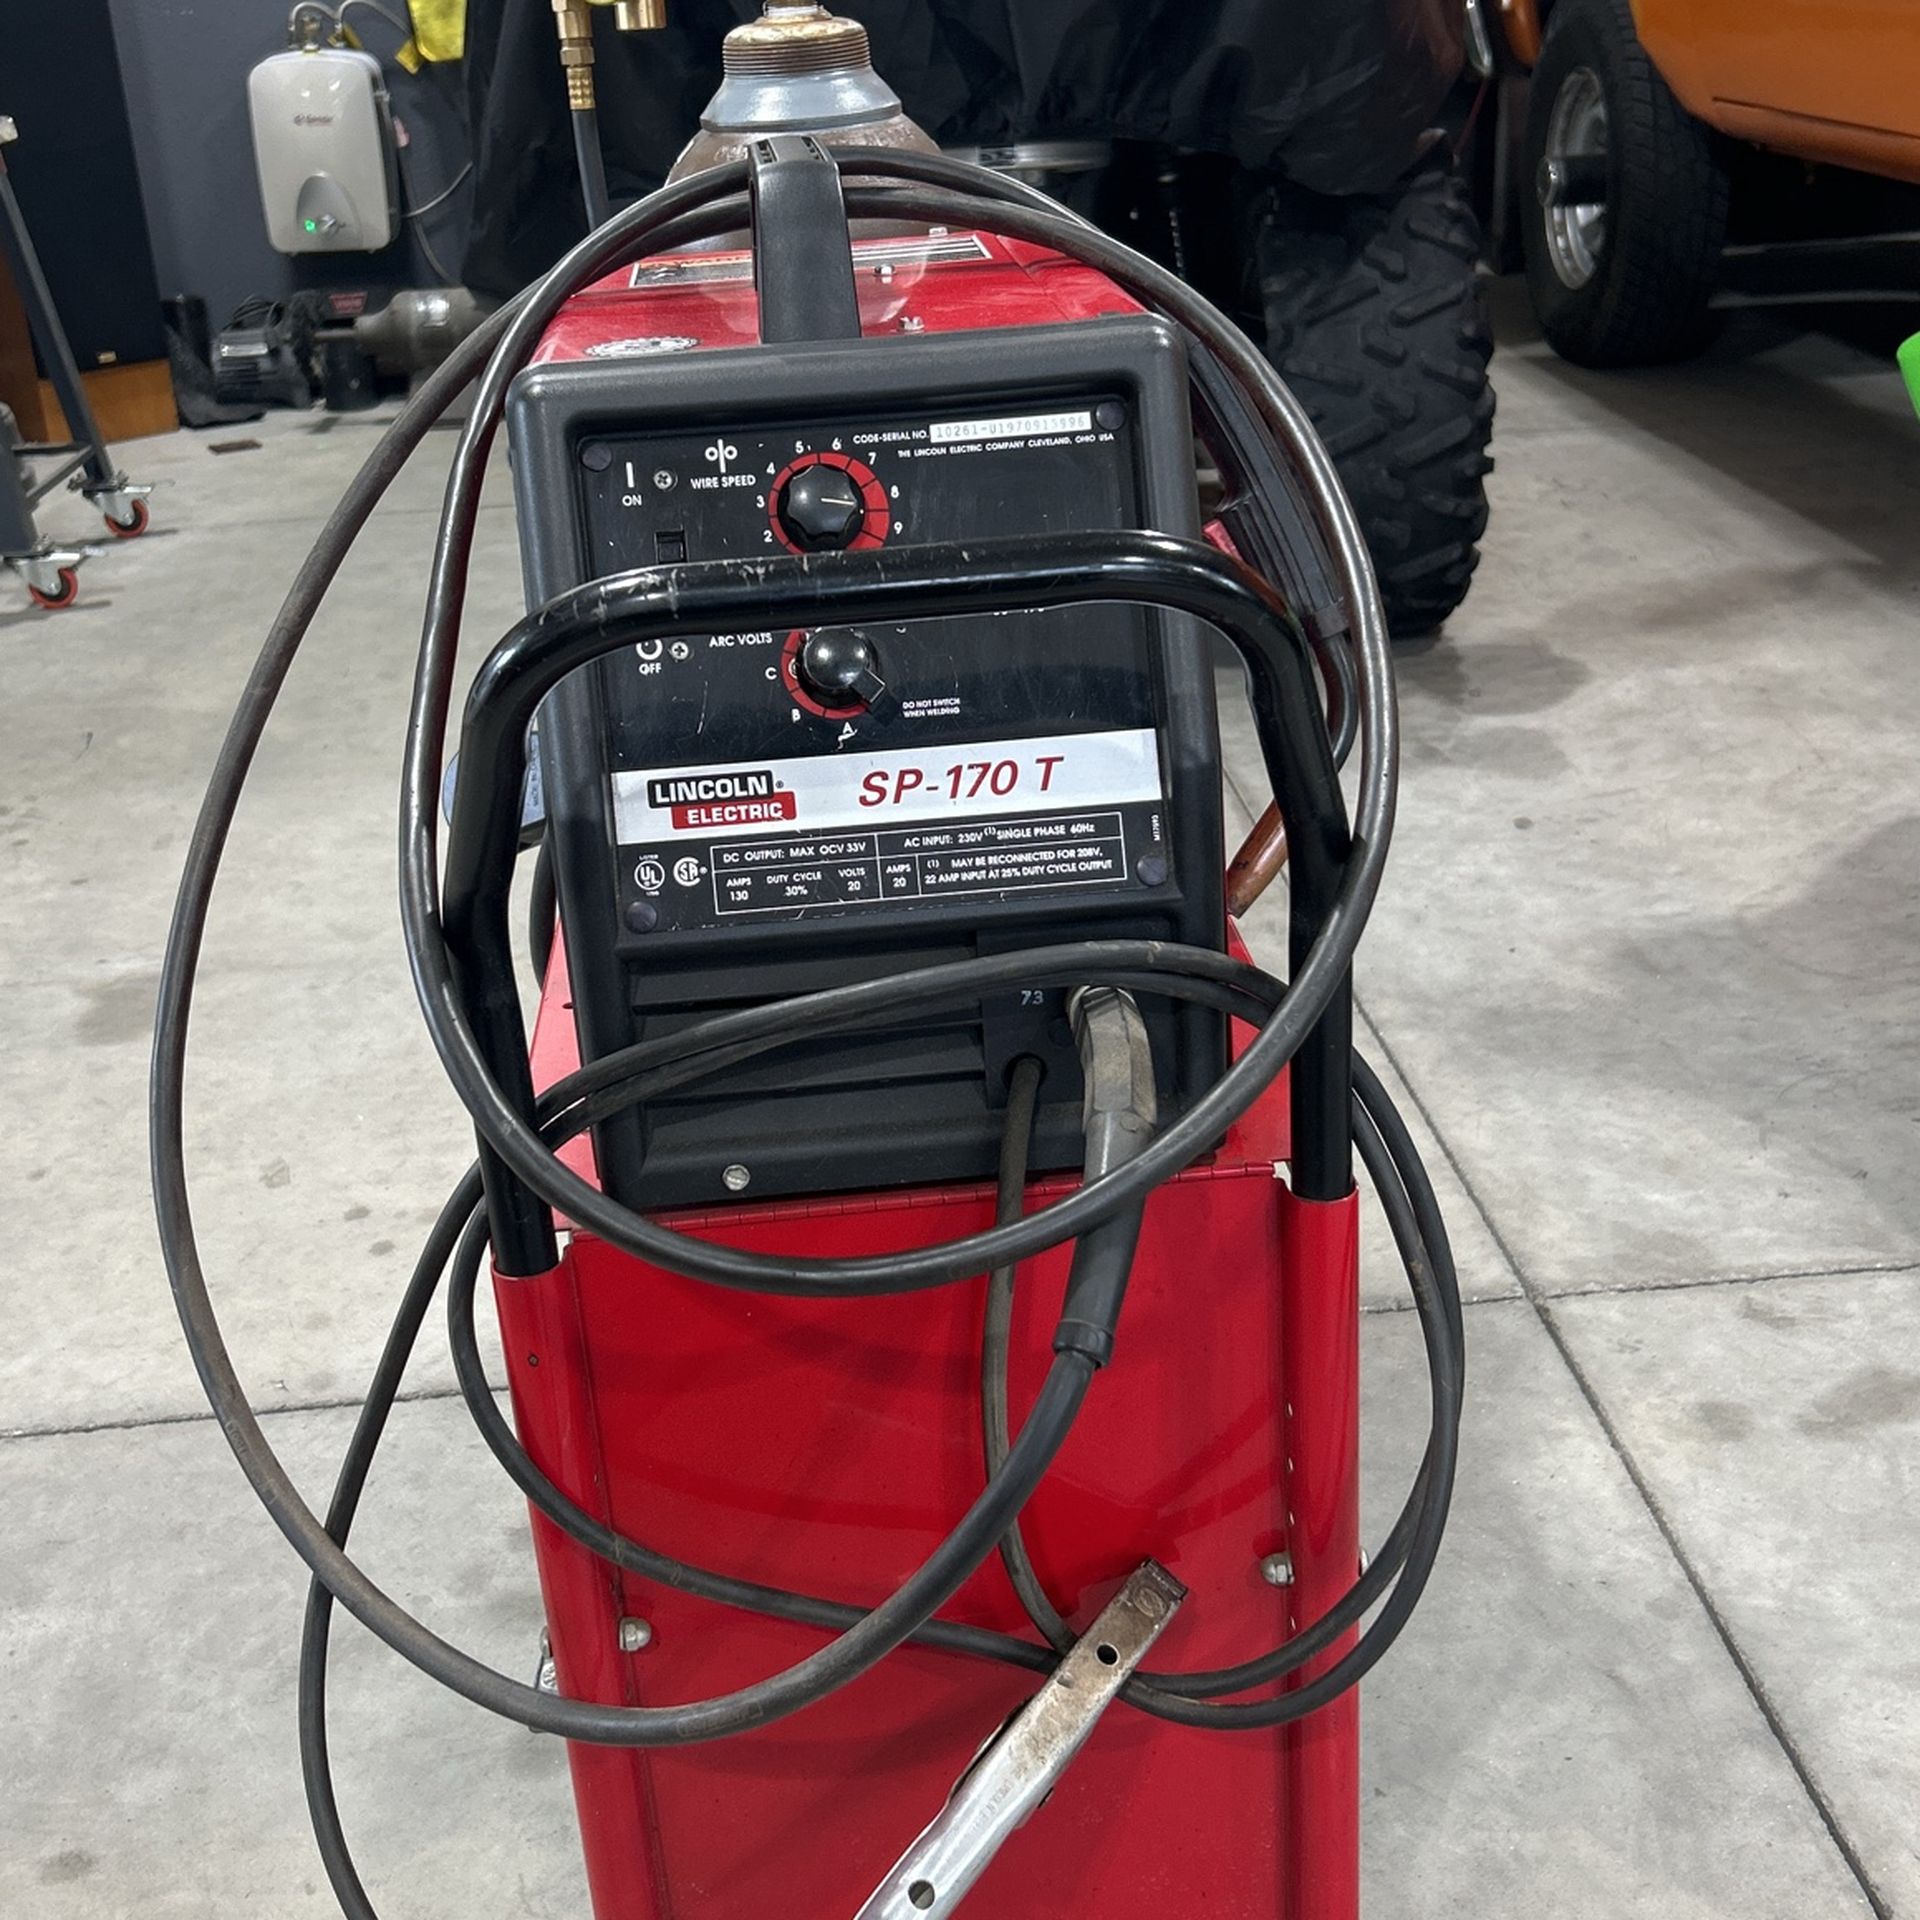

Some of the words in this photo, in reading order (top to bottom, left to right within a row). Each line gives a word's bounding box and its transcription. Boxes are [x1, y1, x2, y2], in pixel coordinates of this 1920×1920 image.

[852, 431, 911, 444] CODE-SERIAL
[912, 429, 930, 440] NO.
[795, 441, 804, 453] 5
[832, 438, 842, 450] 6
[898, 449, 911, 458] THE
[914, 447, 947, 457] LINCOLN
[949, 444, 983, 455] ELECTRIC
[985, 441, 1025, 451] COMPANY
[1075, 434, 1096, 443] OHIO
[1098, 433, 1114, 442] USA
[868, 452, 877, 466] 7
[766, 462, 776, 475] 4
[690, 477, 719, 490] WIRE
[721, 474, 756, 488] SPEED
[891, 485, 899, 498] 8
[622, 495, 642, 507] ON
[756, 495, 765, 508] 3
[894, 522, 903, 534] 9
[763, 530, 773, 542] 2
[709, 635, 735, 648] ARC
[737, 632, 773, 646] VOLTS
[639, 662, 662, 676] OFF
[764, 666, 777, 680] C
[902, 701, 915, 709] DO
[916, 699, 931, 708] NOT
[933, 697, 960, 707] SWITCH
[792, 709, 801, 723] B
[903, 709, 925, 718] WHEN
[926, 706, 960, 716] WELDING
[842, 722, 853, 734] A
[858, 759, 1020, 808] SP-170
[1035, 756, 1064, 792] T
[655, 775, 769, 804] LINCOLN
[687, 802, 783, 825] ELECTRIC
[904, 837, 921, 848] AC
[922, 834, 954, 847] INPUT:
[957, 832, 983, 844] 230V
[997, 827, 1032, 841] SINGLE
[1034, 824, 1066, 837] PHASE
[1070, 822, 1095, 835] 60Hz
[723, 853, 740, 864] DC
[744, 849, 786, 862] OUTPUT:
[790, 846, 815, 858] MAX
[819, 844, 845, 856] OCV
[846, 842, 866, 853] 33V
[927, 859, 939, 869] (1)
[951, 857, 973, 868] MAY
[975, 856, 986, 866] BE
[988, 851, 1056, 866] RECONNECTED
[1056, 849, 1076, 860] FOR
[886, 863, 912, 874] AMPS
[924, 874, 936, 885] 22
[938, 872, 960, 883] AMP
[961, 869, 987, 881] INPUT
[988, 868, 1000, 879] AT
[1000, 867, 1021, 878] 25%
[1021, 865, 1045, 876] DUTY
[1046, 862, 1077, 874] CYCLE
[1078, 859, 1112, 871] OUTPUT
[725, 877, 752, 888] AMPS
[766, 873, 789, 884] DUTY
[792, 871, 822, 882] CYCLE
[838, 867, 866, 878] VOLTS
[892, 877, 907, 888] 20
[730, 891, 749, 901] 130
[784, 885, 808, 897] 30%
[848, 881, 861, 892] 20
[1021, 990, 1044, 1006] 73
